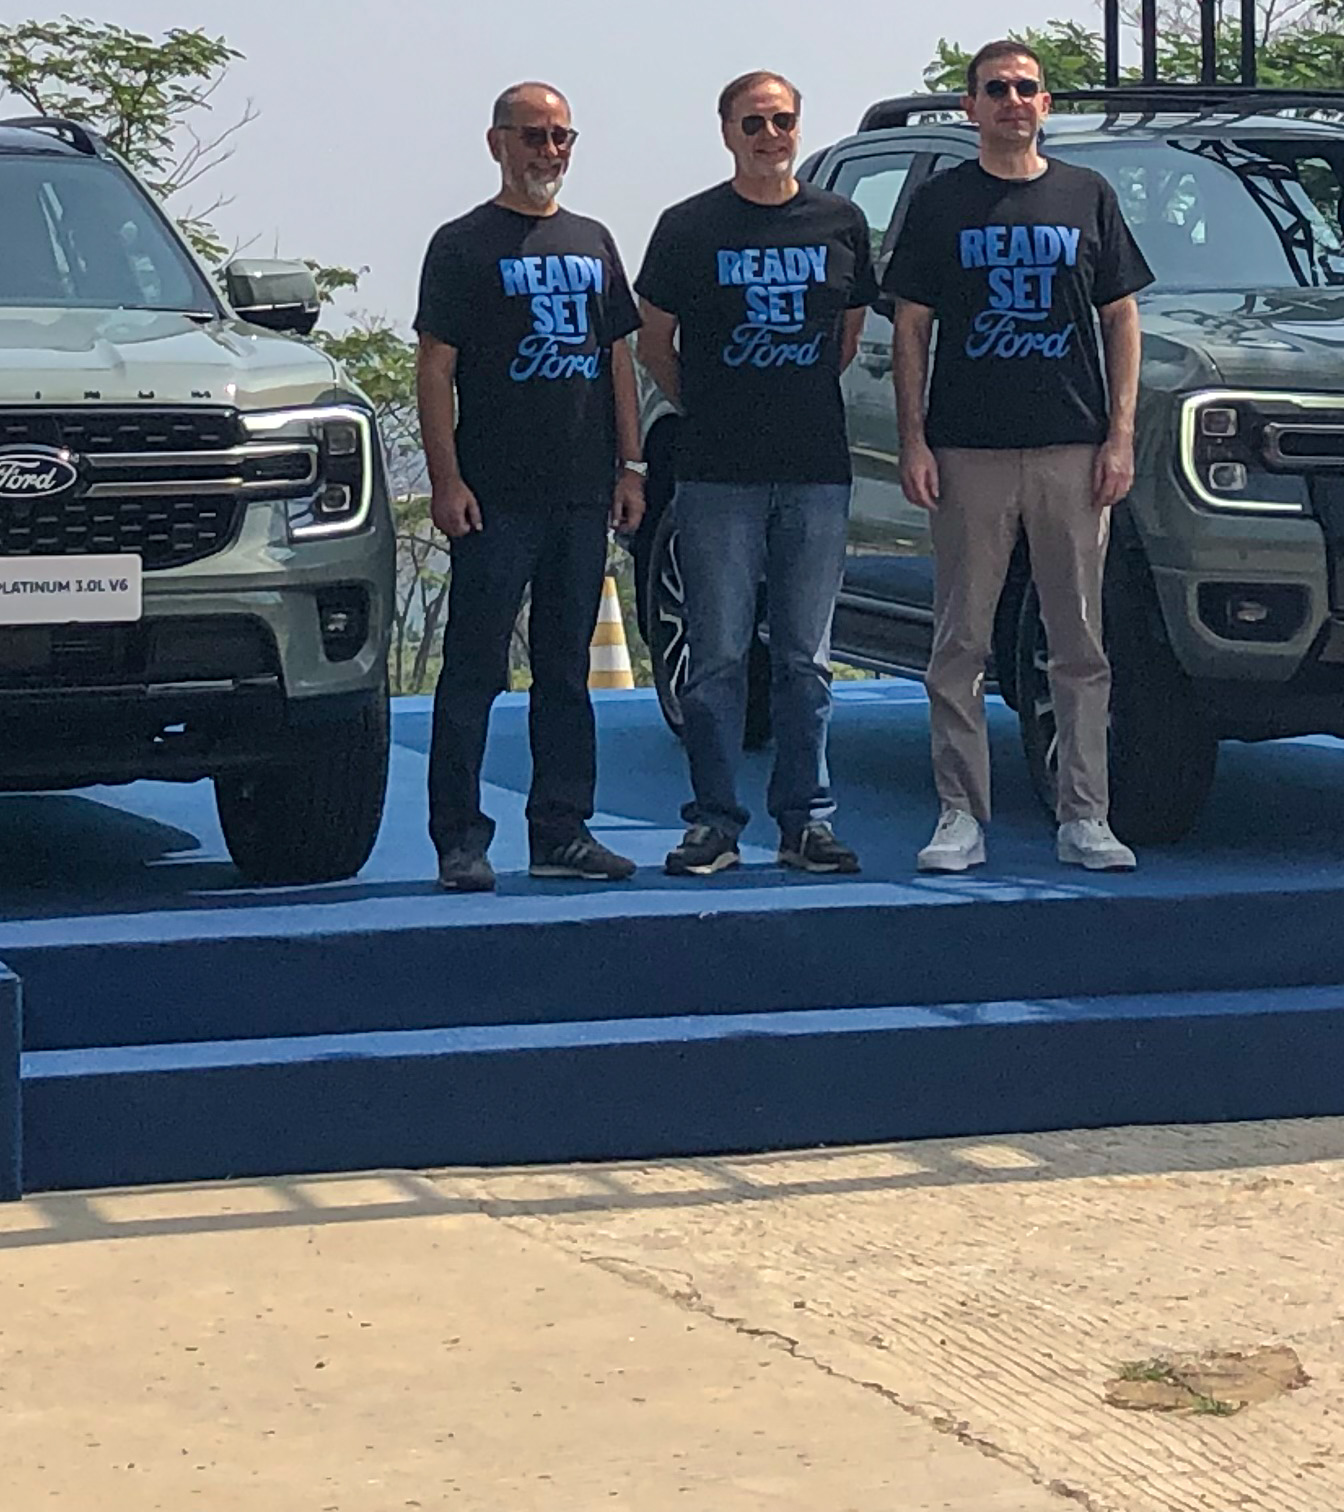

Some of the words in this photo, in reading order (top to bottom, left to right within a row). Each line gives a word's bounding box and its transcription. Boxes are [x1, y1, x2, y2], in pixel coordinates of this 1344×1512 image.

[716, 245, 828, 286] READY
[960, 225, 1081, 269] READY
[498, 254, 604, 297] READY
[988, 266, 1057, 309] SET
[530, 292, 589, 334] SET
[744, 284, 809, 324] SET
[723, 322, 827, 368] Ford
[965, 309, 1077, 359] Ford
[509, 333, 602, 382] Ford
[75, 578, 106, 593] 3.0L
[108, 577, 129, 592] V6
